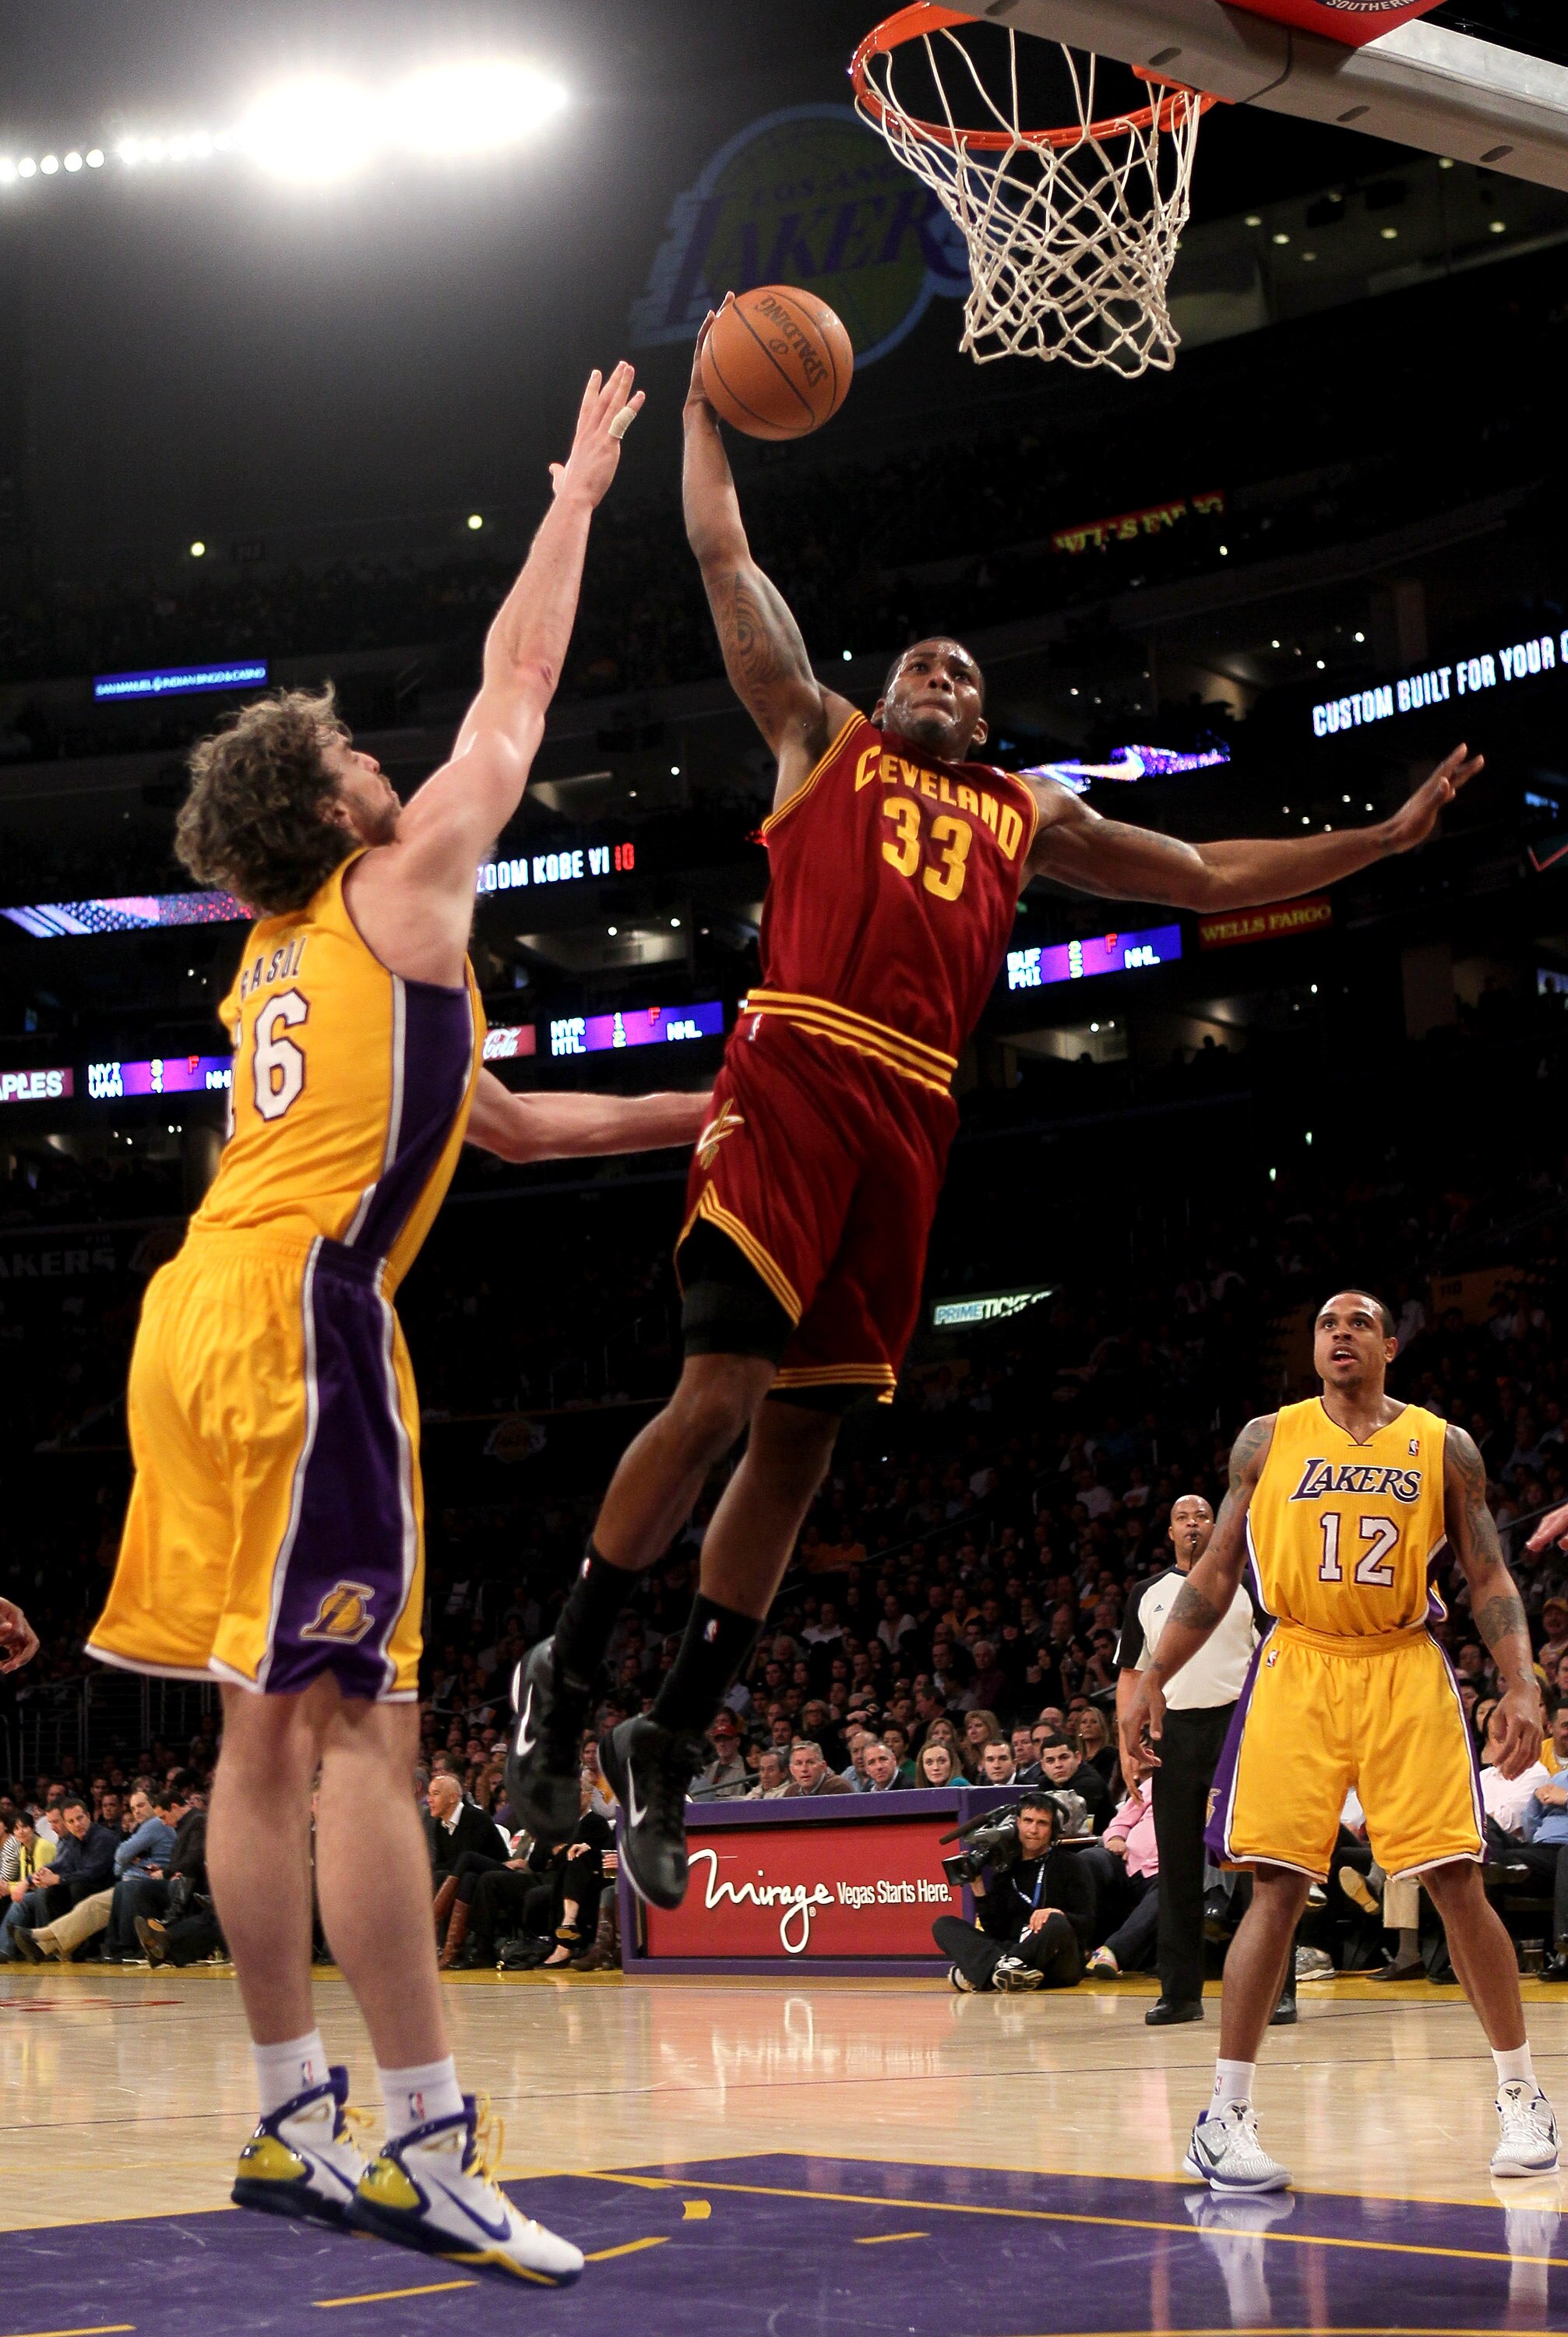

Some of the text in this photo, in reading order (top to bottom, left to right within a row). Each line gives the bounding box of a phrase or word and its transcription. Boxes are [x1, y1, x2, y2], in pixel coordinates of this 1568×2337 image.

[668, 187, 980, 327] LAKER
[753, 295, 828, 387] SPALDING
[1313, 685, 1394, 737] CUSTOM
[1397, 665, 1451, 712] BUILT
[1456, 654, 1496, 695] FOR
[1499, 636, 1556, 681] YOUR
[476, 842, 635, 893] ZOOM KOBE VI 10
[881, 796, 973, 901] 33
[1201, 904, 1332, 942] WELLS FARGO
[1007, 948, 1041, 971] BUF
[1105, 933, 1118, 953] F
[1008, 967, 1042, 990] PHI
[1125, 945, 1161, 969] NHL
[550, 1017, 586, 1039] NYR
[648, 1006, 661, 1027] F
[667, 1020, 703, 1042] NHL
[0, 1070, 64, 1101] PLES
[88, 1061, 121, 1082] NYI
[187, 1054, 200, 1075] F
[206, 1070, 232, 1090] NH
[1288, 1457, 1424, 1505] LAKERS
[1318, 1511, 1400, 1588] 12
[837, 1881, 876, 1909] Vegas
[877, 1879, 915, 1905] Starts
[917, 1878, 953, 1904] Here.
